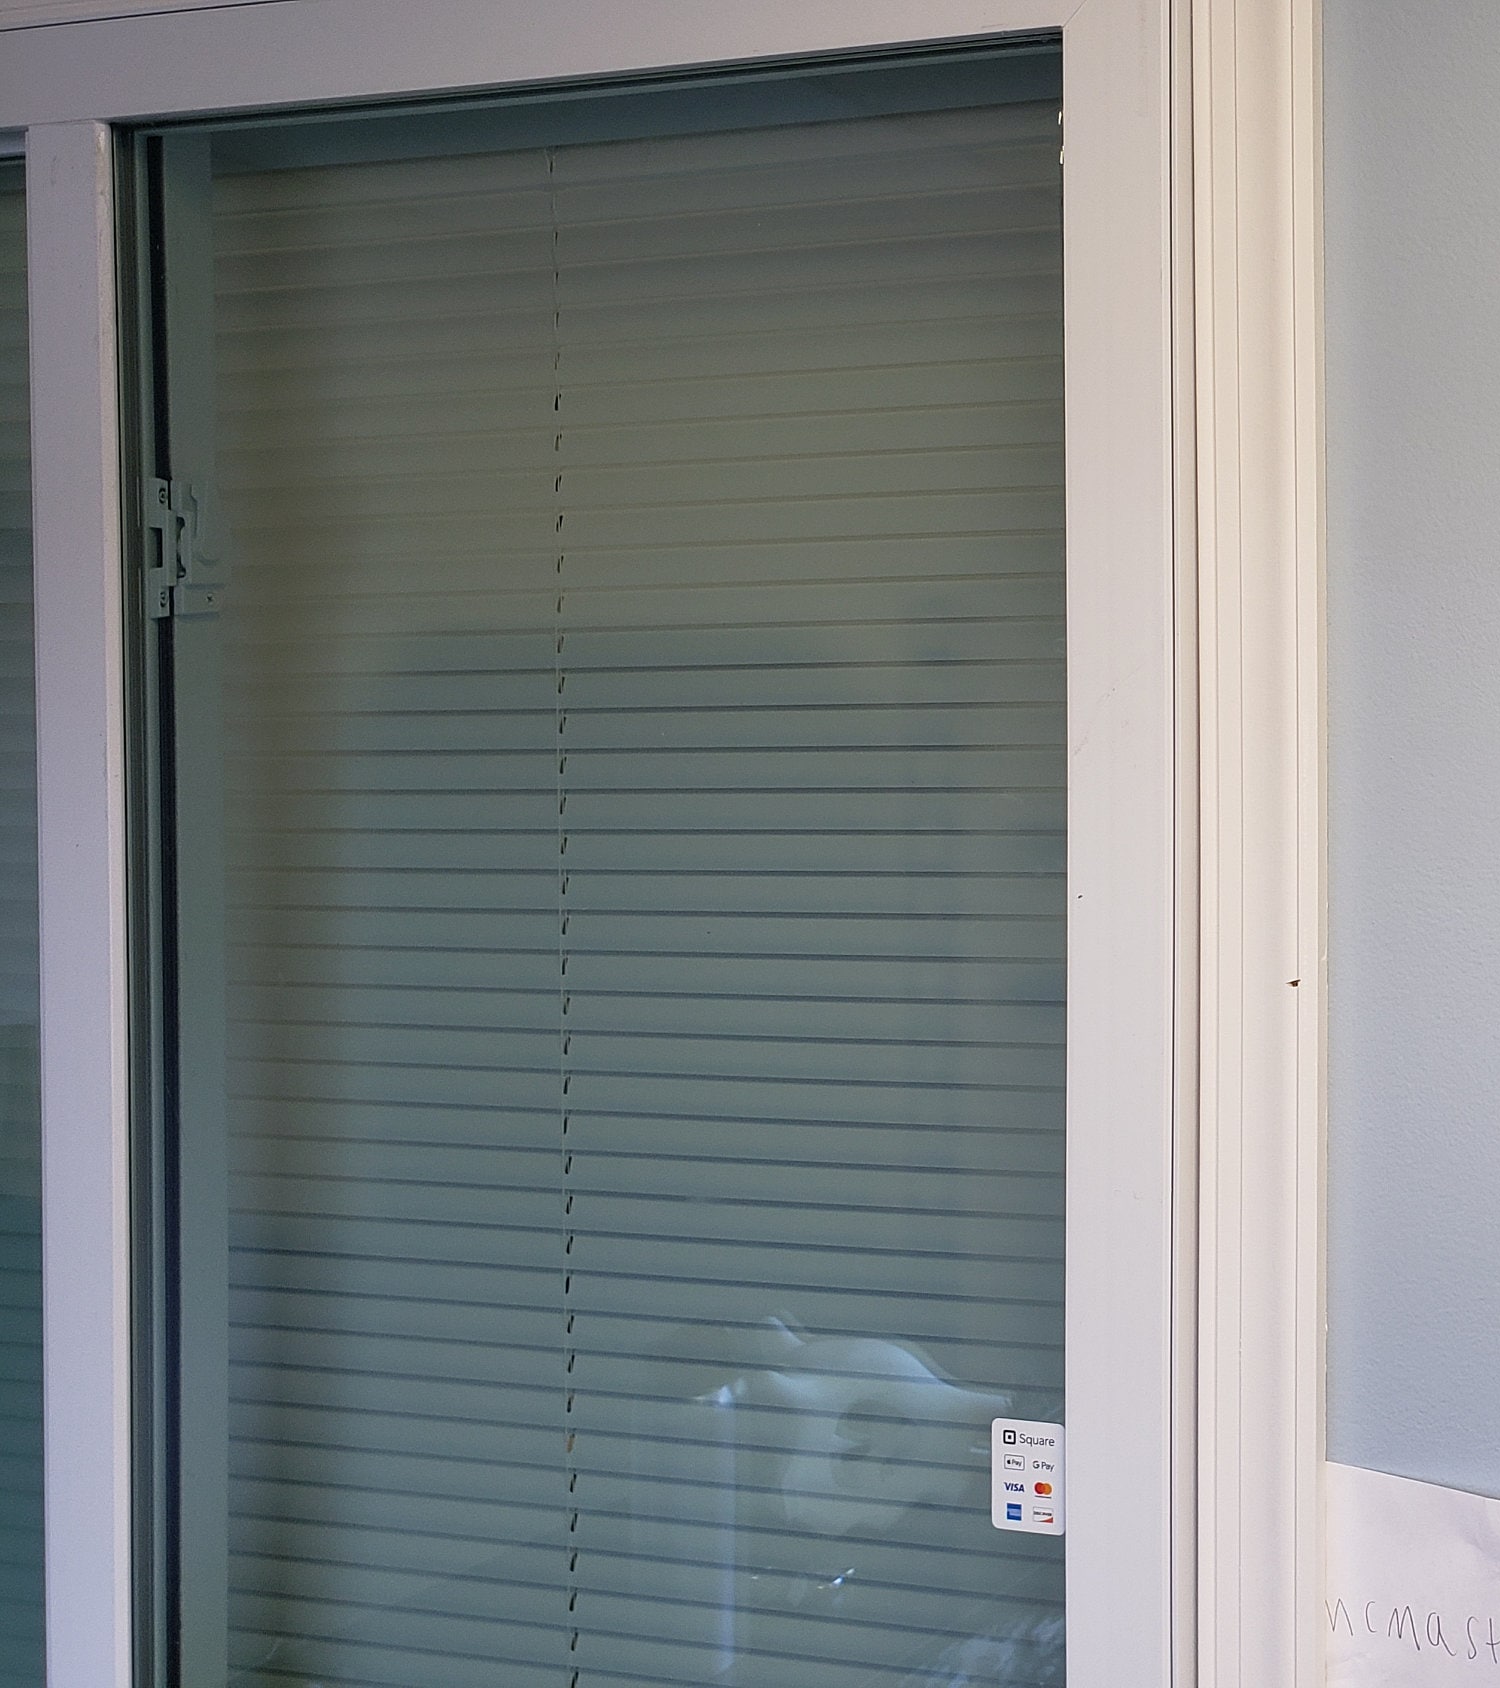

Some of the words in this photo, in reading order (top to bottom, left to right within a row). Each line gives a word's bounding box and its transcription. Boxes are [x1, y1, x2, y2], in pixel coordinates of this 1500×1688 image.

[1019, 1433, 1055, 1446] Square
[1011, 1458, 1022, 1467] Pay
[1041, 1461, 1054, 1472] Pay
[1004, 1482, 1024, 1492] VISA
